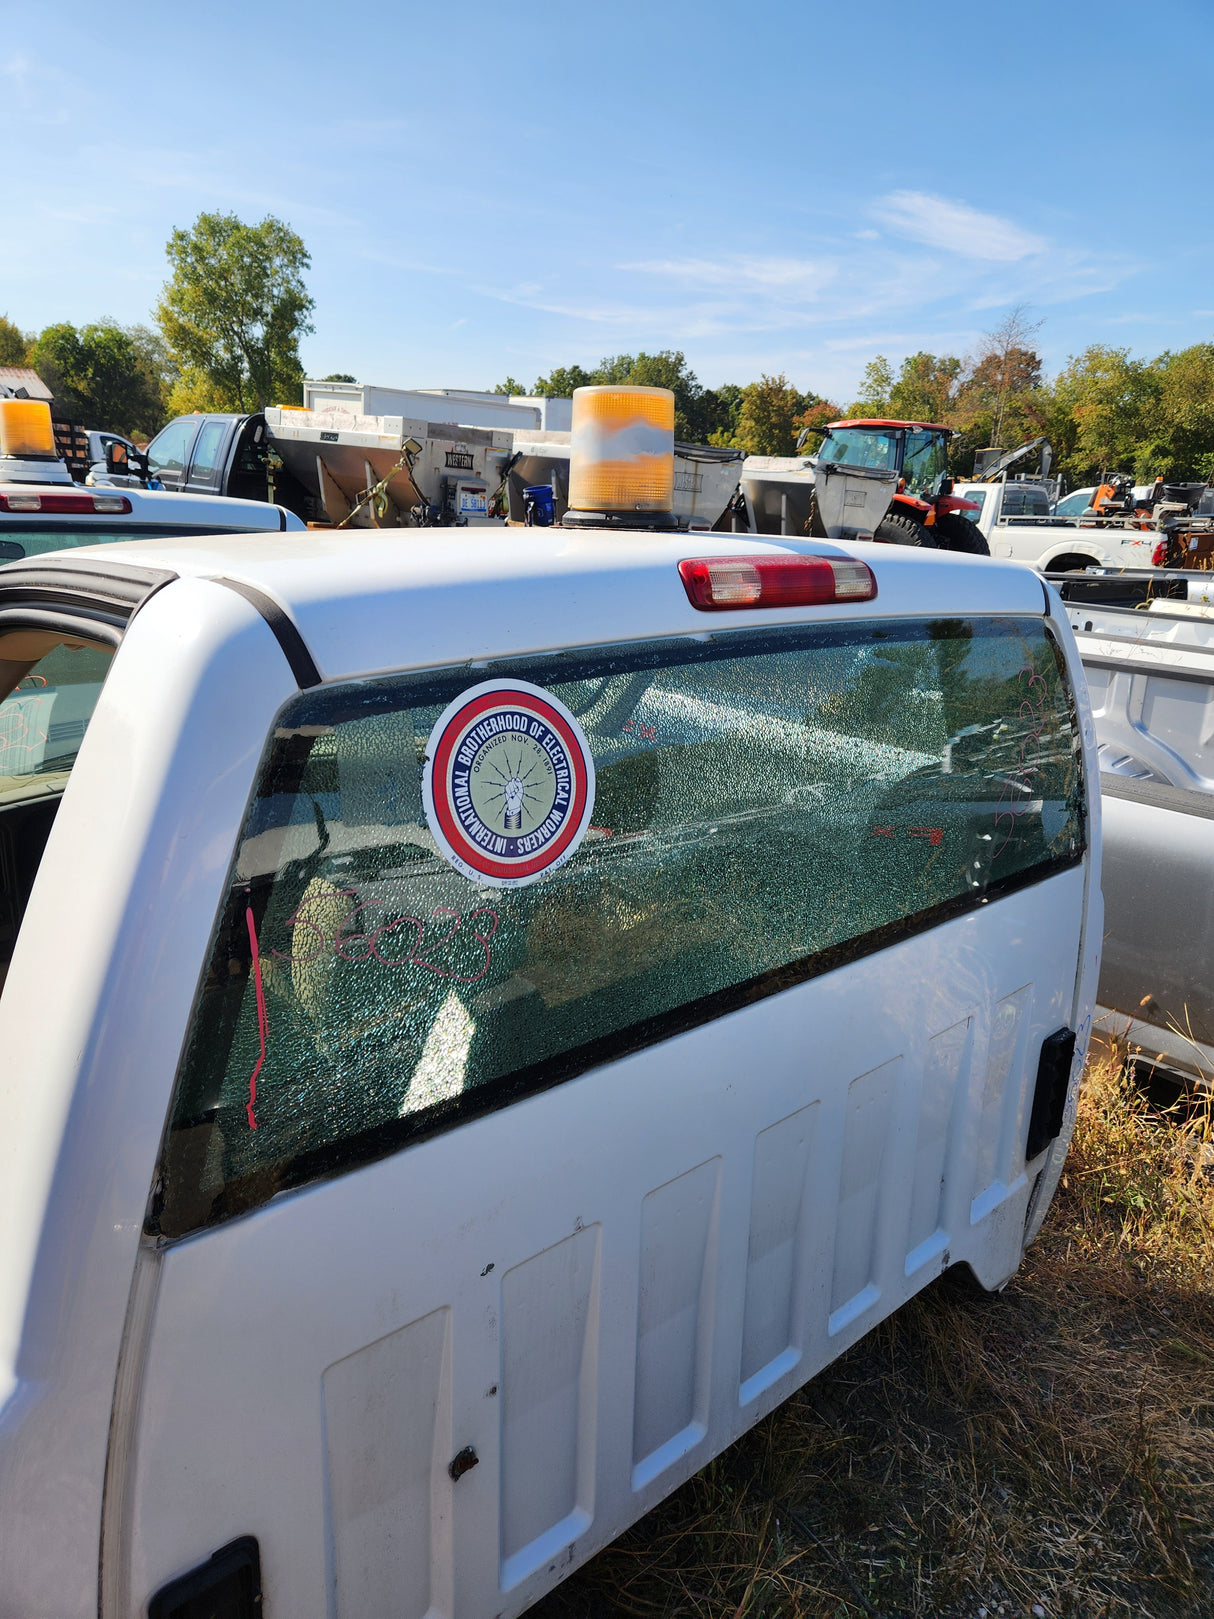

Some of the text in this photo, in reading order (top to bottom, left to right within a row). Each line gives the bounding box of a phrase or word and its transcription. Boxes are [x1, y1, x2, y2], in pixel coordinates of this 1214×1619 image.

[447, 453, 472, 468] WESTERN
[457, 714, 528, 767] BROTHERHOOD
[473, 735, 507, 773] ORGANIZED
[511, 734, 529, 746] NOV.
[542, 757, 553, 775] 1891
[529, 721, 545, 739] OF
[542, 733, 570, 806] ELECTRICAL
[454, 769, 507, 855] INTERNATIONAL
[517, 808, 564, 855] WORKERS
[272, 889, 498, 982] 56023
